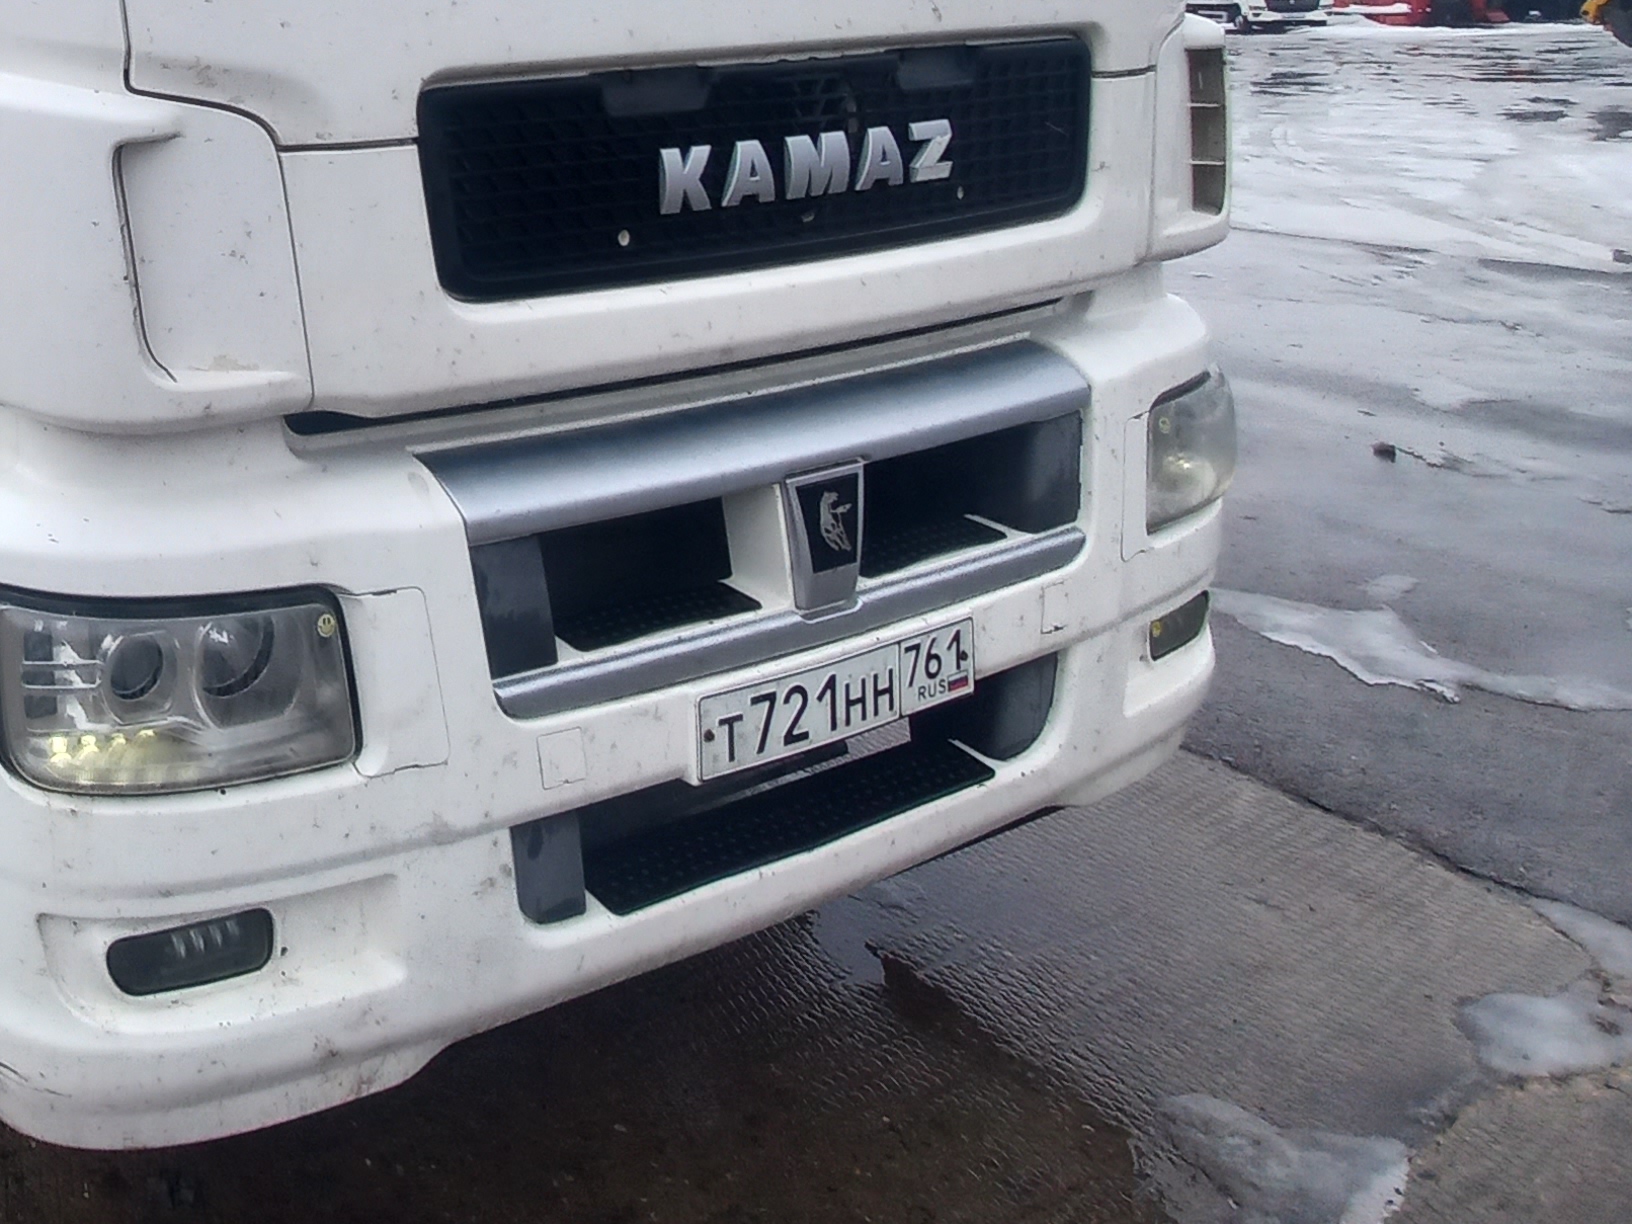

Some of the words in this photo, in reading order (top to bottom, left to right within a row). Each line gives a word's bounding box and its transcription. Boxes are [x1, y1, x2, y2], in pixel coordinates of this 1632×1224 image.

[658, 118, 955, 215] KAMAZ
[717, 666, 895, 763] Т721НН
[903, 628, 963, 689] 761
[917, 677, 948, 701] RUS
